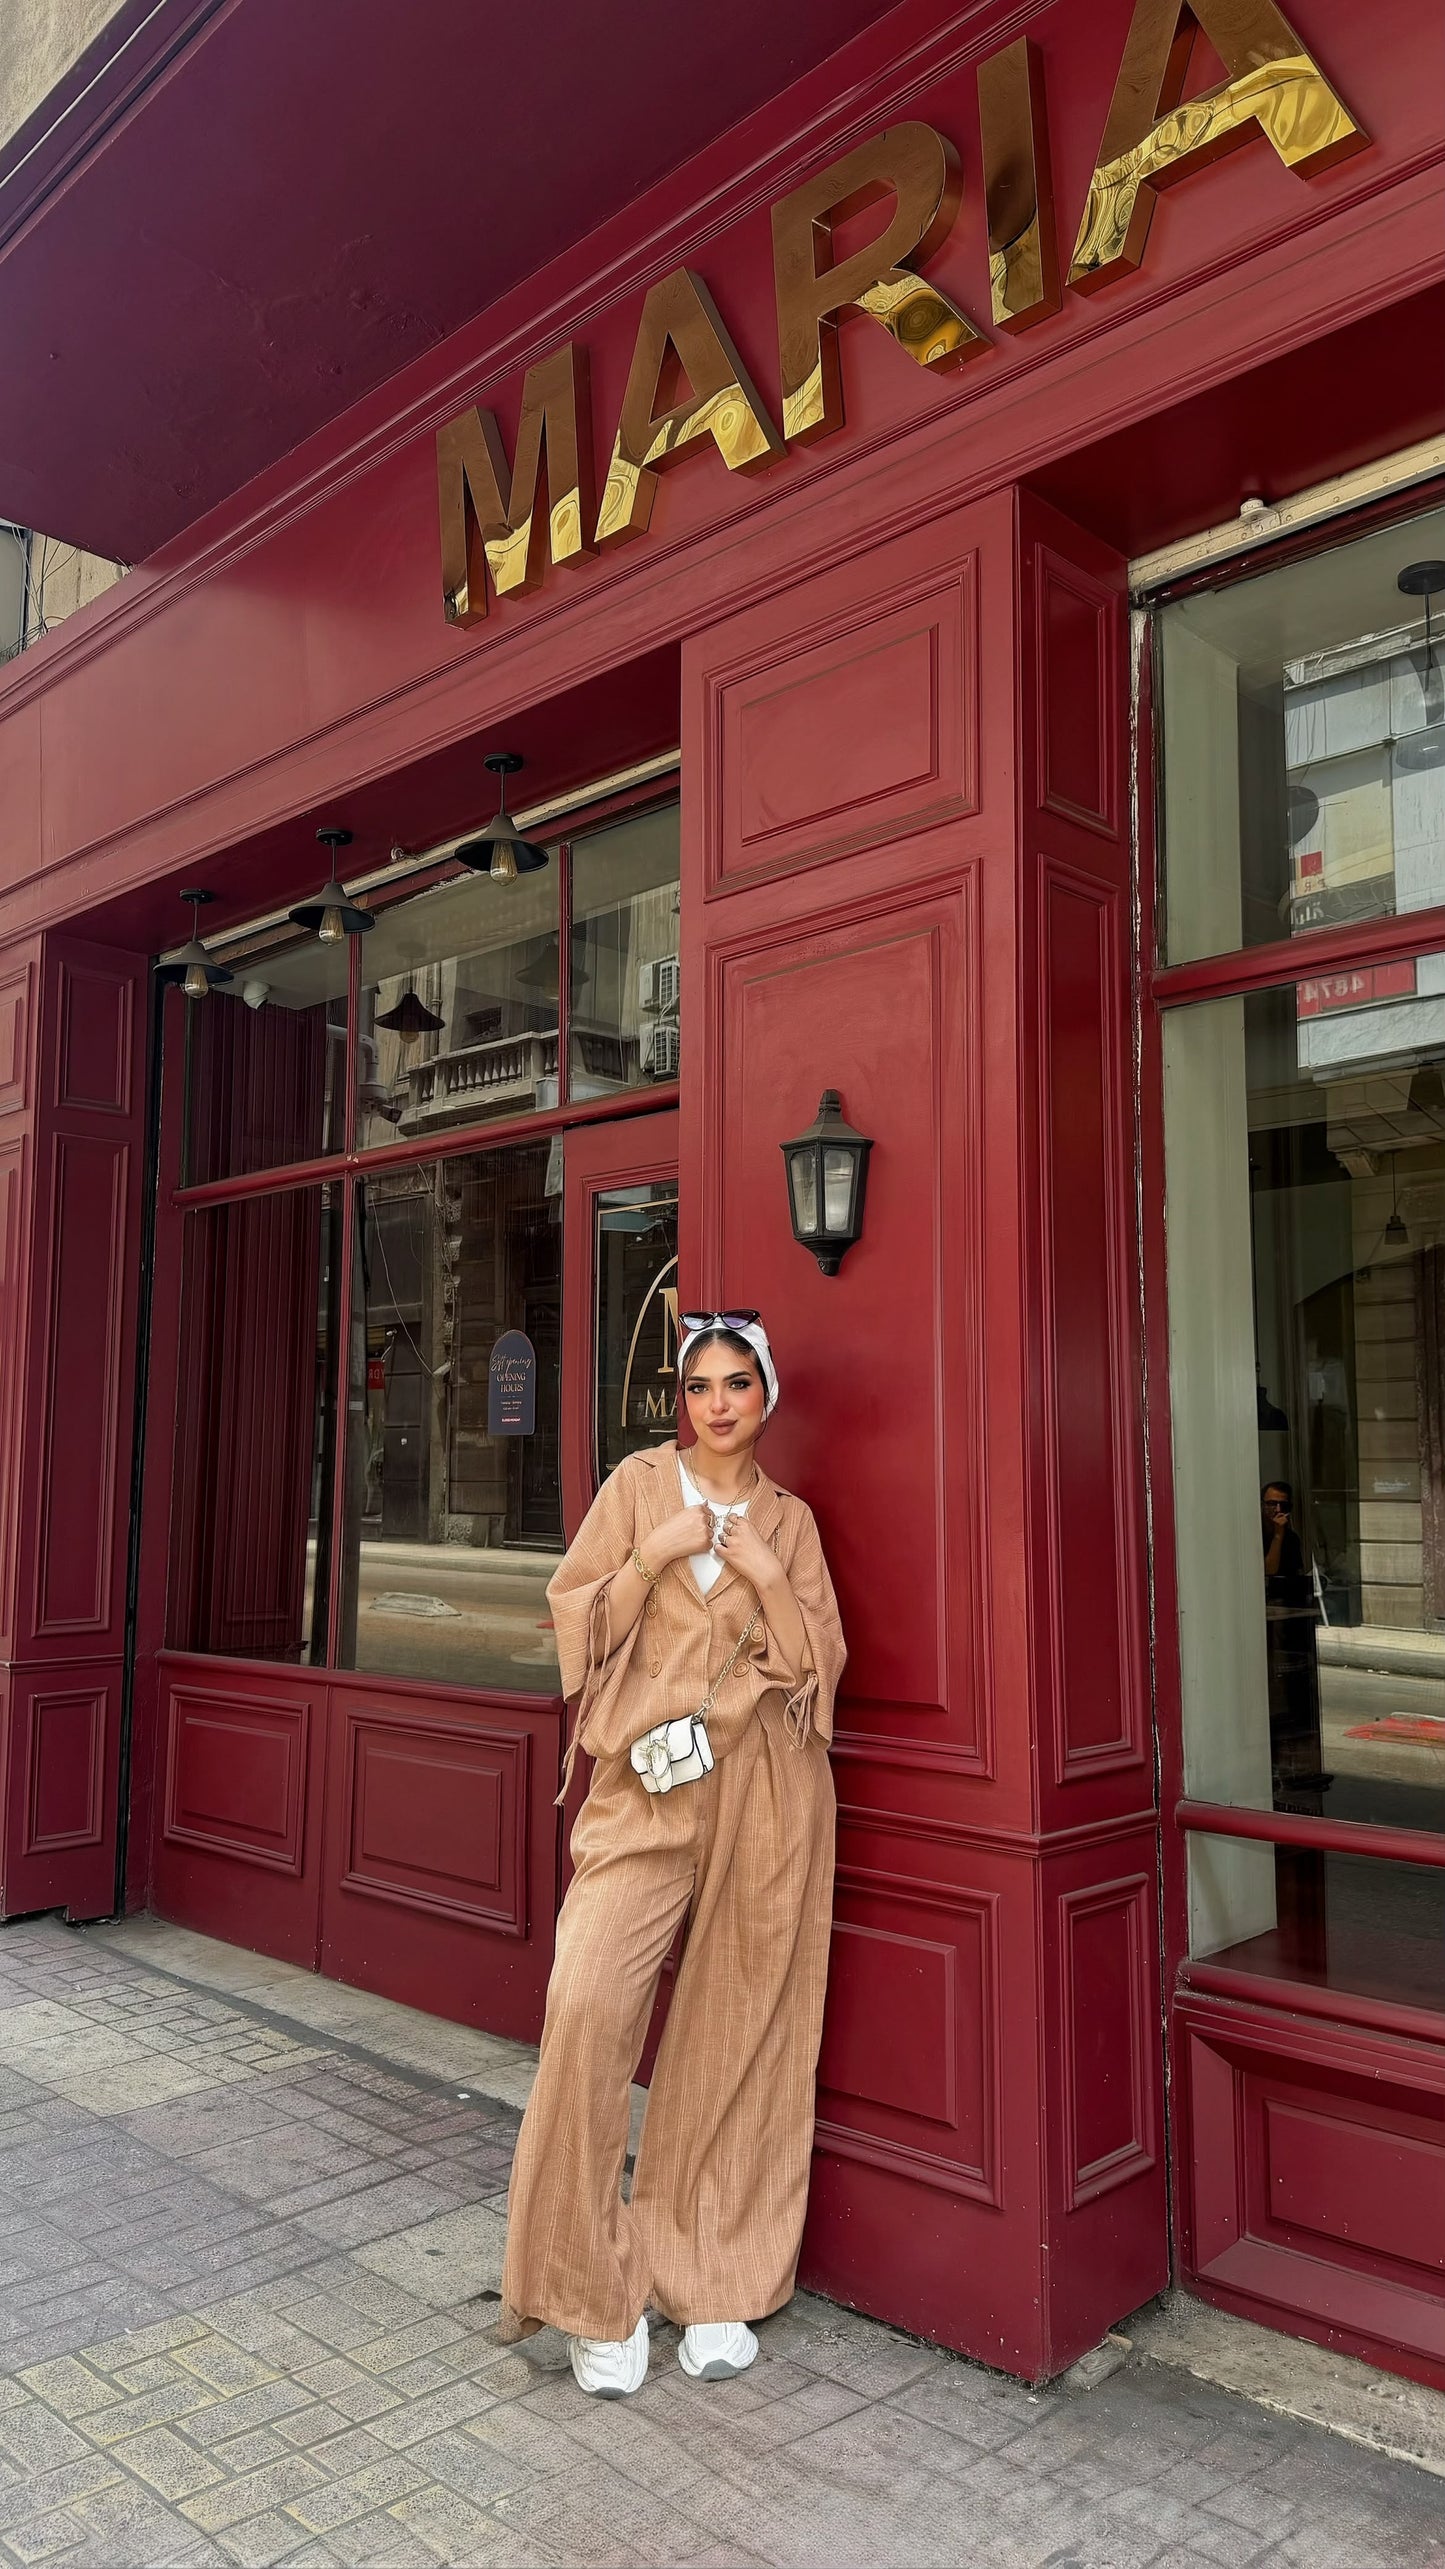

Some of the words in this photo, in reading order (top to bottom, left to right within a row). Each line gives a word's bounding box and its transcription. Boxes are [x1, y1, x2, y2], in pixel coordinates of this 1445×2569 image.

[436, 0, 1372, 630] MARIA
[496, 1372, 526, 1382] OPENING
[500, 1383, 524, 1393] HOURS
